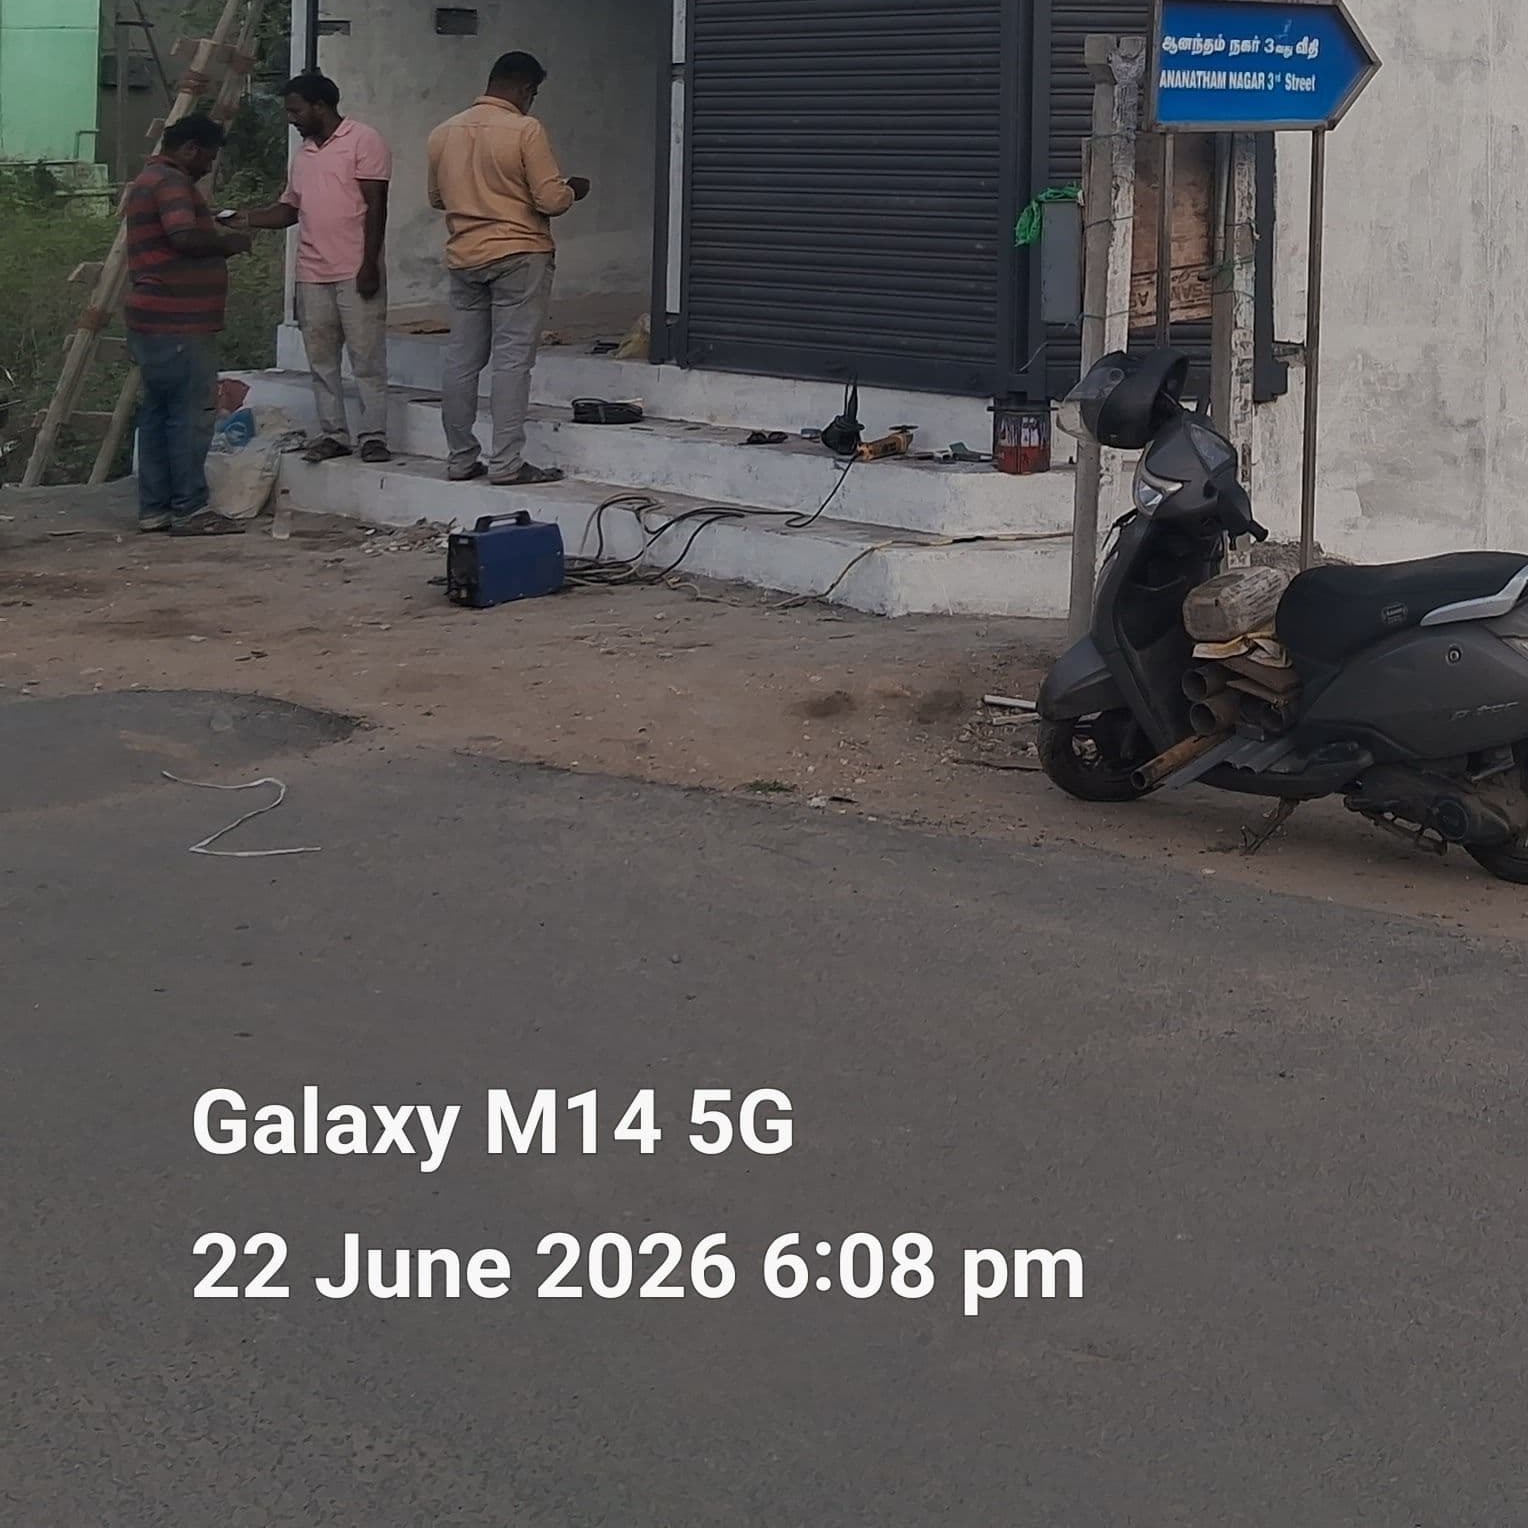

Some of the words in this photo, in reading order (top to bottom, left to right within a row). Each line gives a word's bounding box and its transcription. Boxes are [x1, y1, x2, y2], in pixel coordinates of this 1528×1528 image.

[1162, 33, 1225, 56] ஆனந்தம்
[1228, 35, 1260, 56] நகர்
[1295, 36, 1319, 60] வீதி
[1160, 70, 1226, 89] ANANATHAM
[1228, 71, 1265, 90] NAGAR
[1285, 73, 1316, 91] Street
